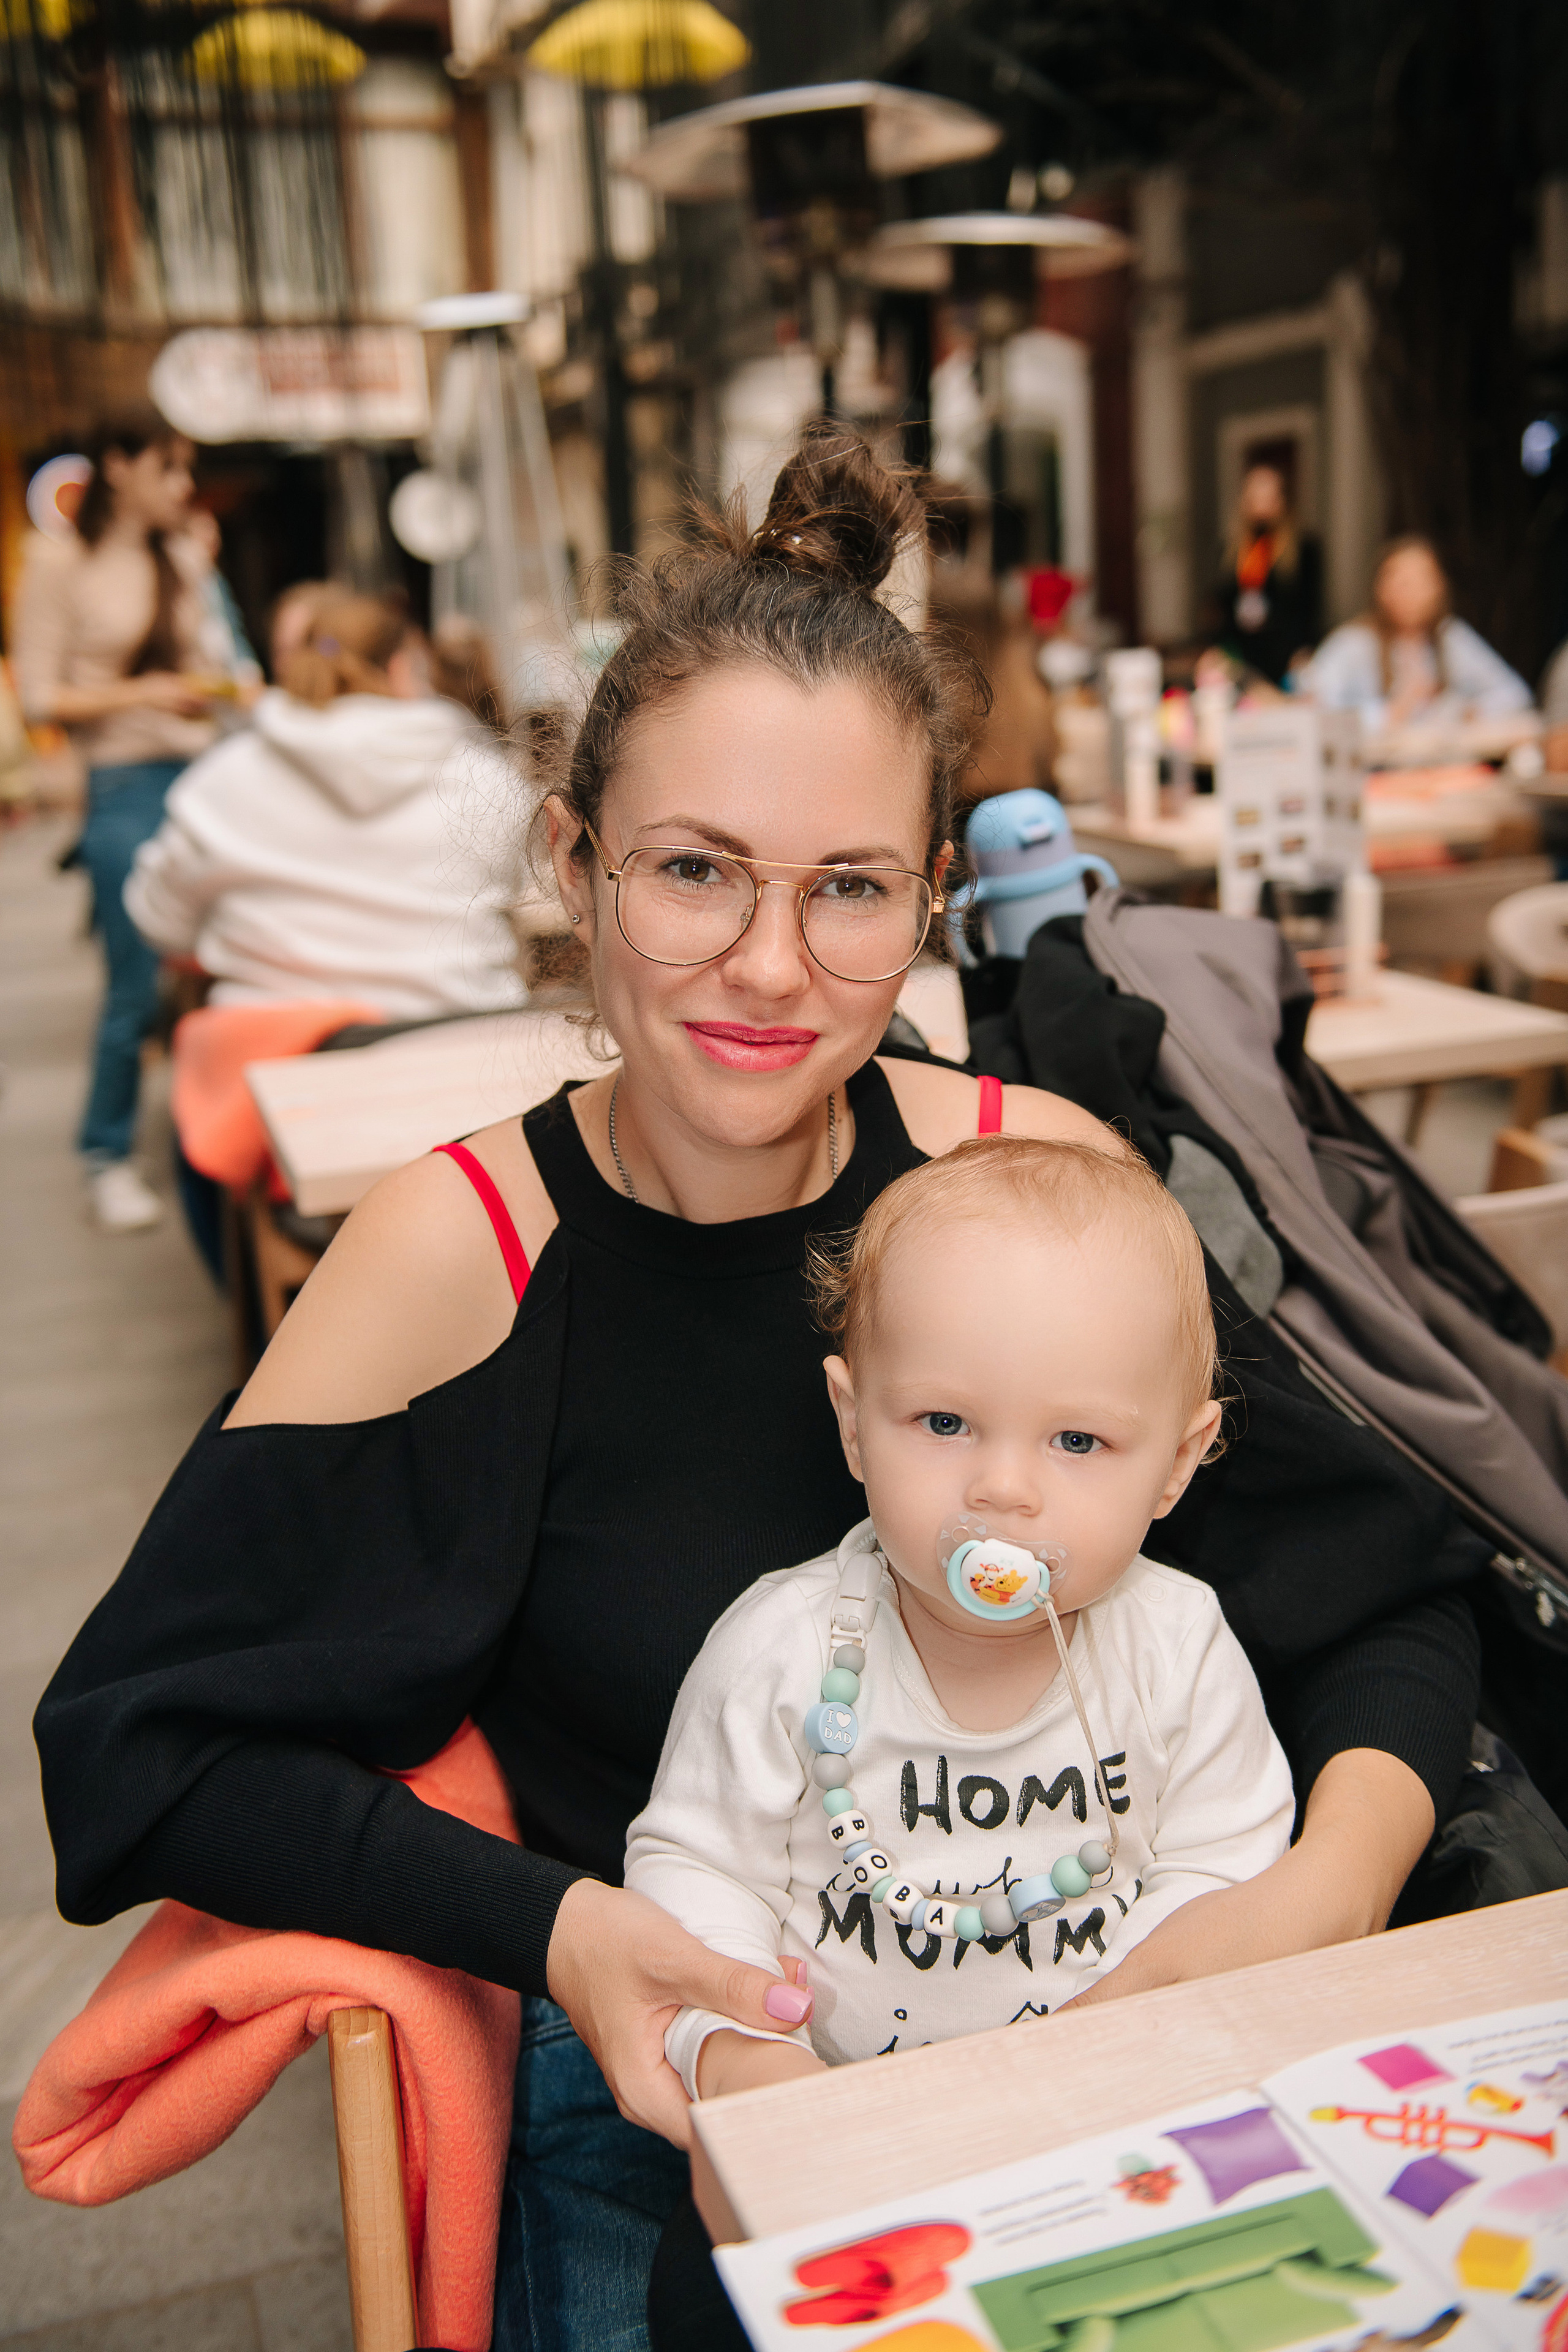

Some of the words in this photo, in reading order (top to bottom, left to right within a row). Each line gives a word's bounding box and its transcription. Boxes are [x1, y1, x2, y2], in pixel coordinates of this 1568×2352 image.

[827, 1709, 835, 1724] I
[824, 1726, 852, 1744] DAD
[900, 1751, 1131, 1836] HOME
